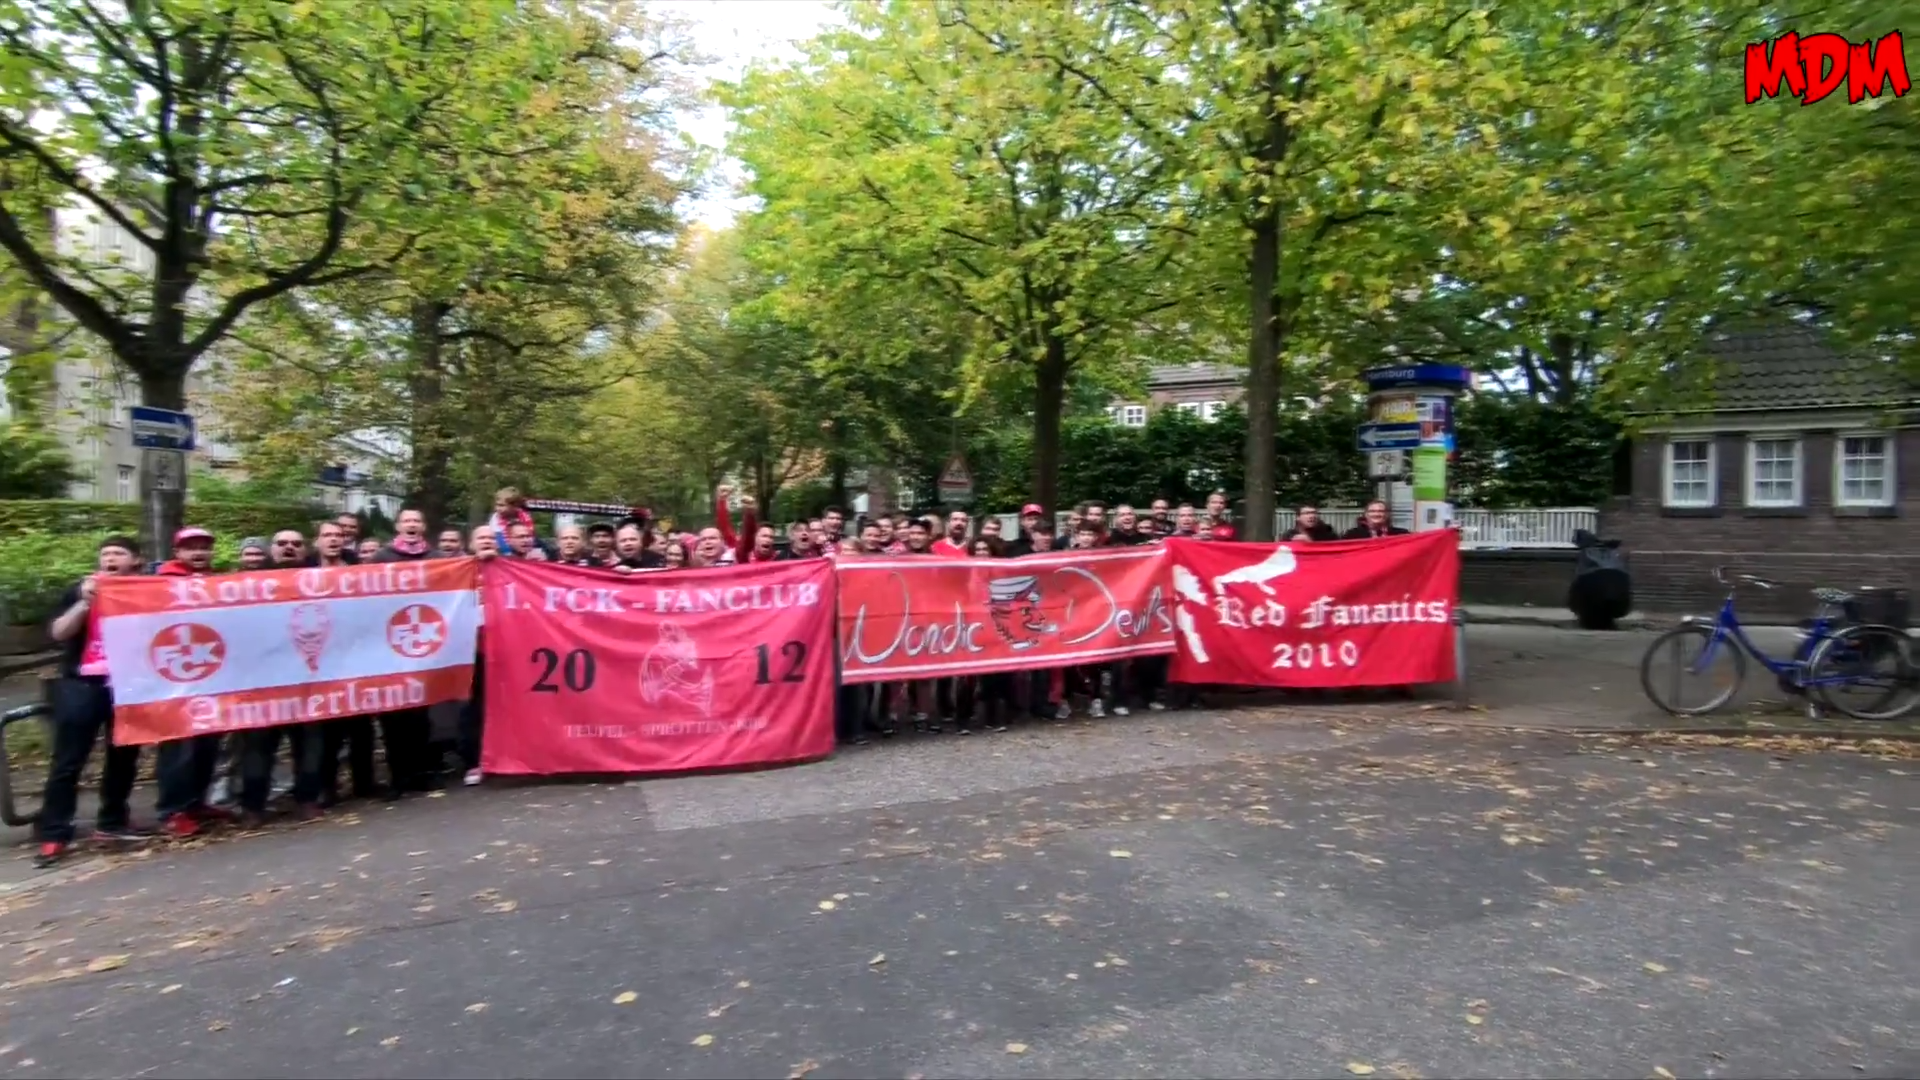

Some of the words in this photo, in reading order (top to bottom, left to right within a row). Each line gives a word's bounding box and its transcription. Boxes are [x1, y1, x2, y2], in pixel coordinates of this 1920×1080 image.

[167, 577, 280, 608] Rote
[298, 561, 429, 597] Teufel
[544, 586, 626, 613] FCK
[655, 582, 820, 613] FANCLUB
[843, 571, 985, 664] Nordic
[1214, 596, 1286, 629] Red
[1297, 593, 1449, 629] Fanatics
[531, 647, 596, 694] 20
[754, 640, 807, 685] 12
[1271, 640, 1359, 669] 2010
[185, 676, 427, 731] Ammerland
